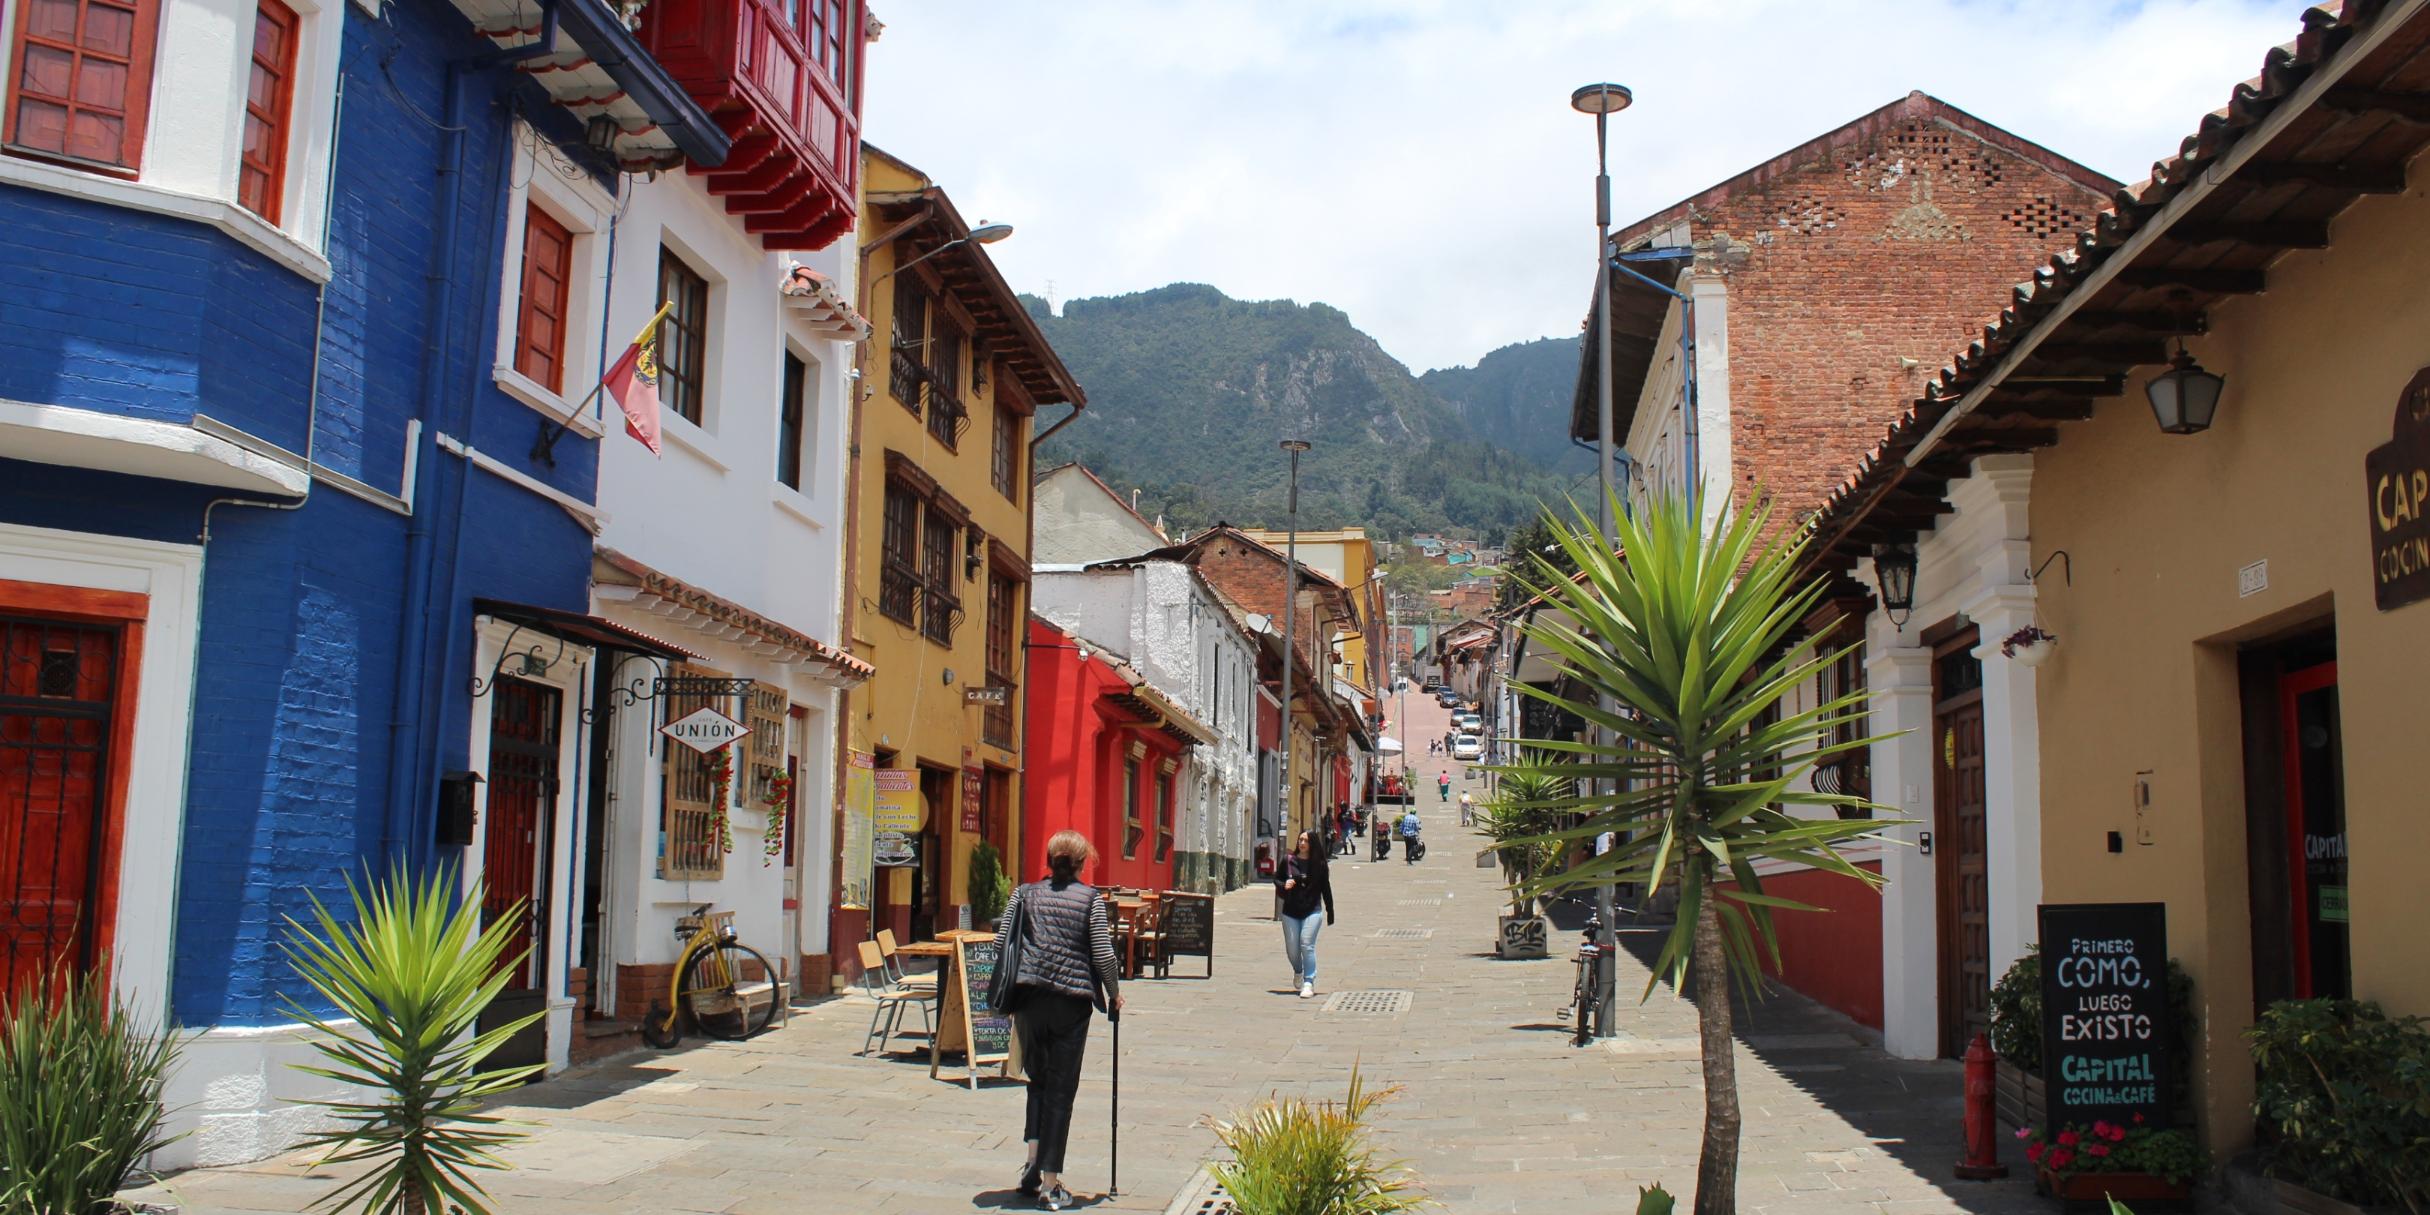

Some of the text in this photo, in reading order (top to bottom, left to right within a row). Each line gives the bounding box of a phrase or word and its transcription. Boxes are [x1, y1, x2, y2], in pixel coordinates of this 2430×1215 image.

[675, 720, 735, 737] UNIÓN
[2058, 956, 2150, 989] COMO,
[2079, 994, 2132, 1011] LUEGO
[2061, 1053, 2155, 1082] CAPITAL
